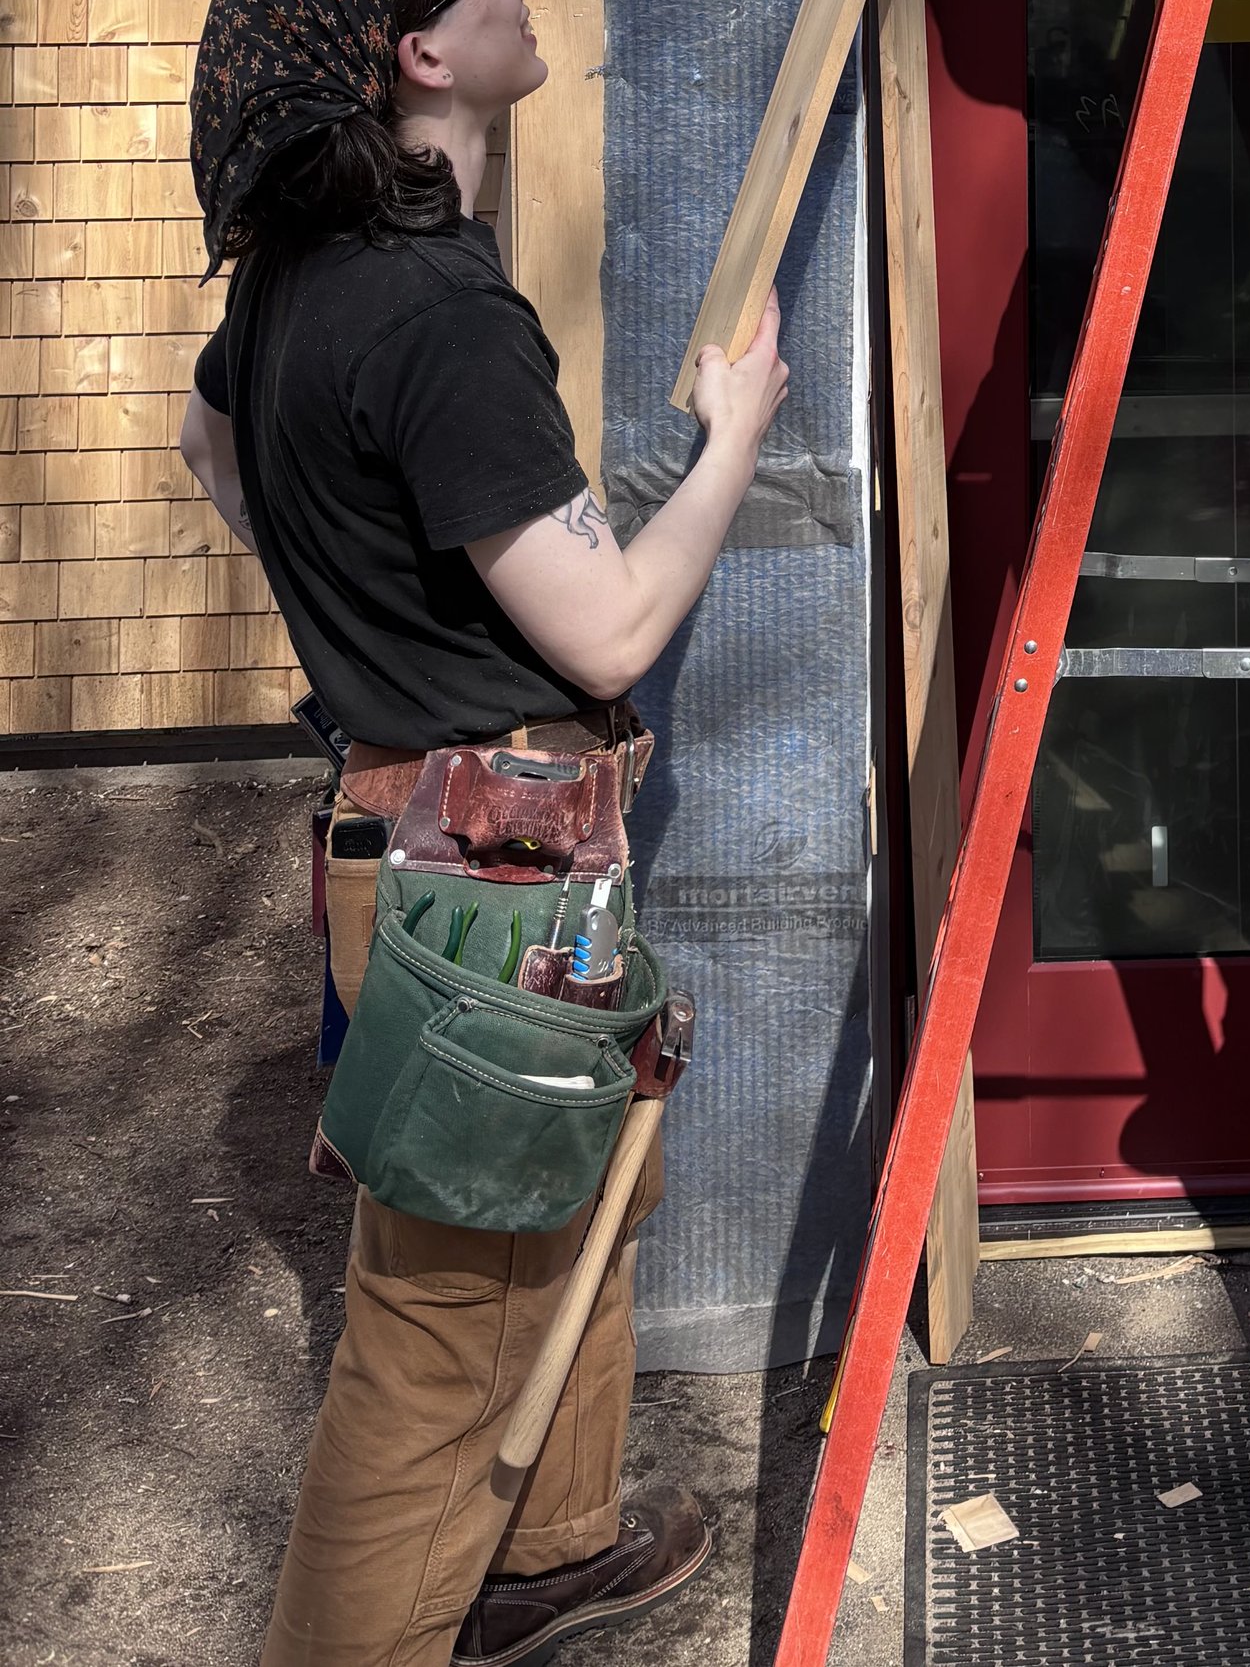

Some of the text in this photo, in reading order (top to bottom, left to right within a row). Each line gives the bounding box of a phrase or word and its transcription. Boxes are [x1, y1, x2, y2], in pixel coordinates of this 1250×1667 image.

[669, 919, 748, 934] Advanced
[751, 916, 812, 933] Building
[816, 914, 868, 931] Produc
